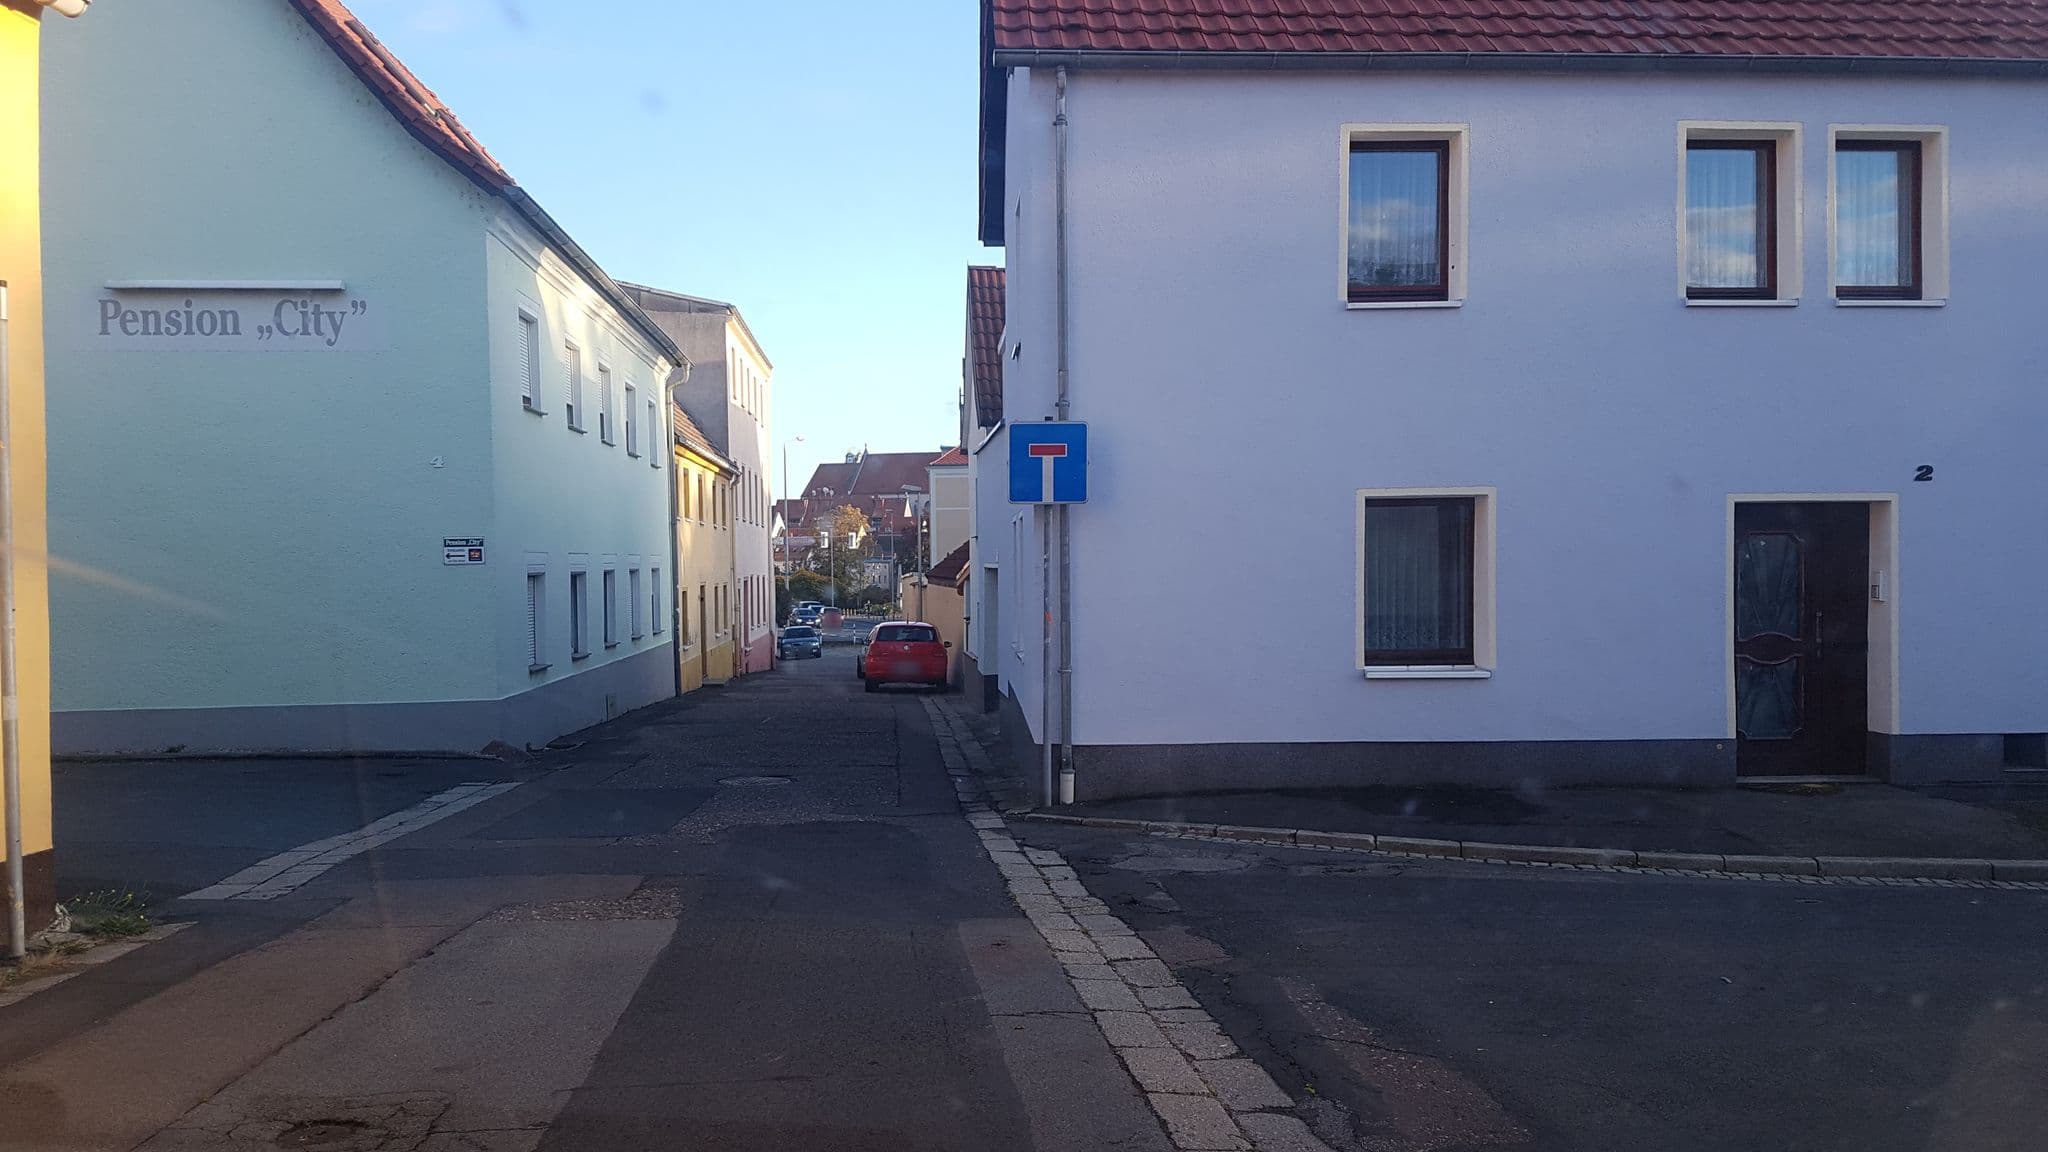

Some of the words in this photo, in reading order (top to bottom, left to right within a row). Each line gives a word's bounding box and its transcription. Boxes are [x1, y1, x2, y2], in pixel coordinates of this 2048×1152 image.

[98, 298, 242, 337] Pension
[429, 456, 446, 469] 4
[1913, 464, 1934, 482] 2
